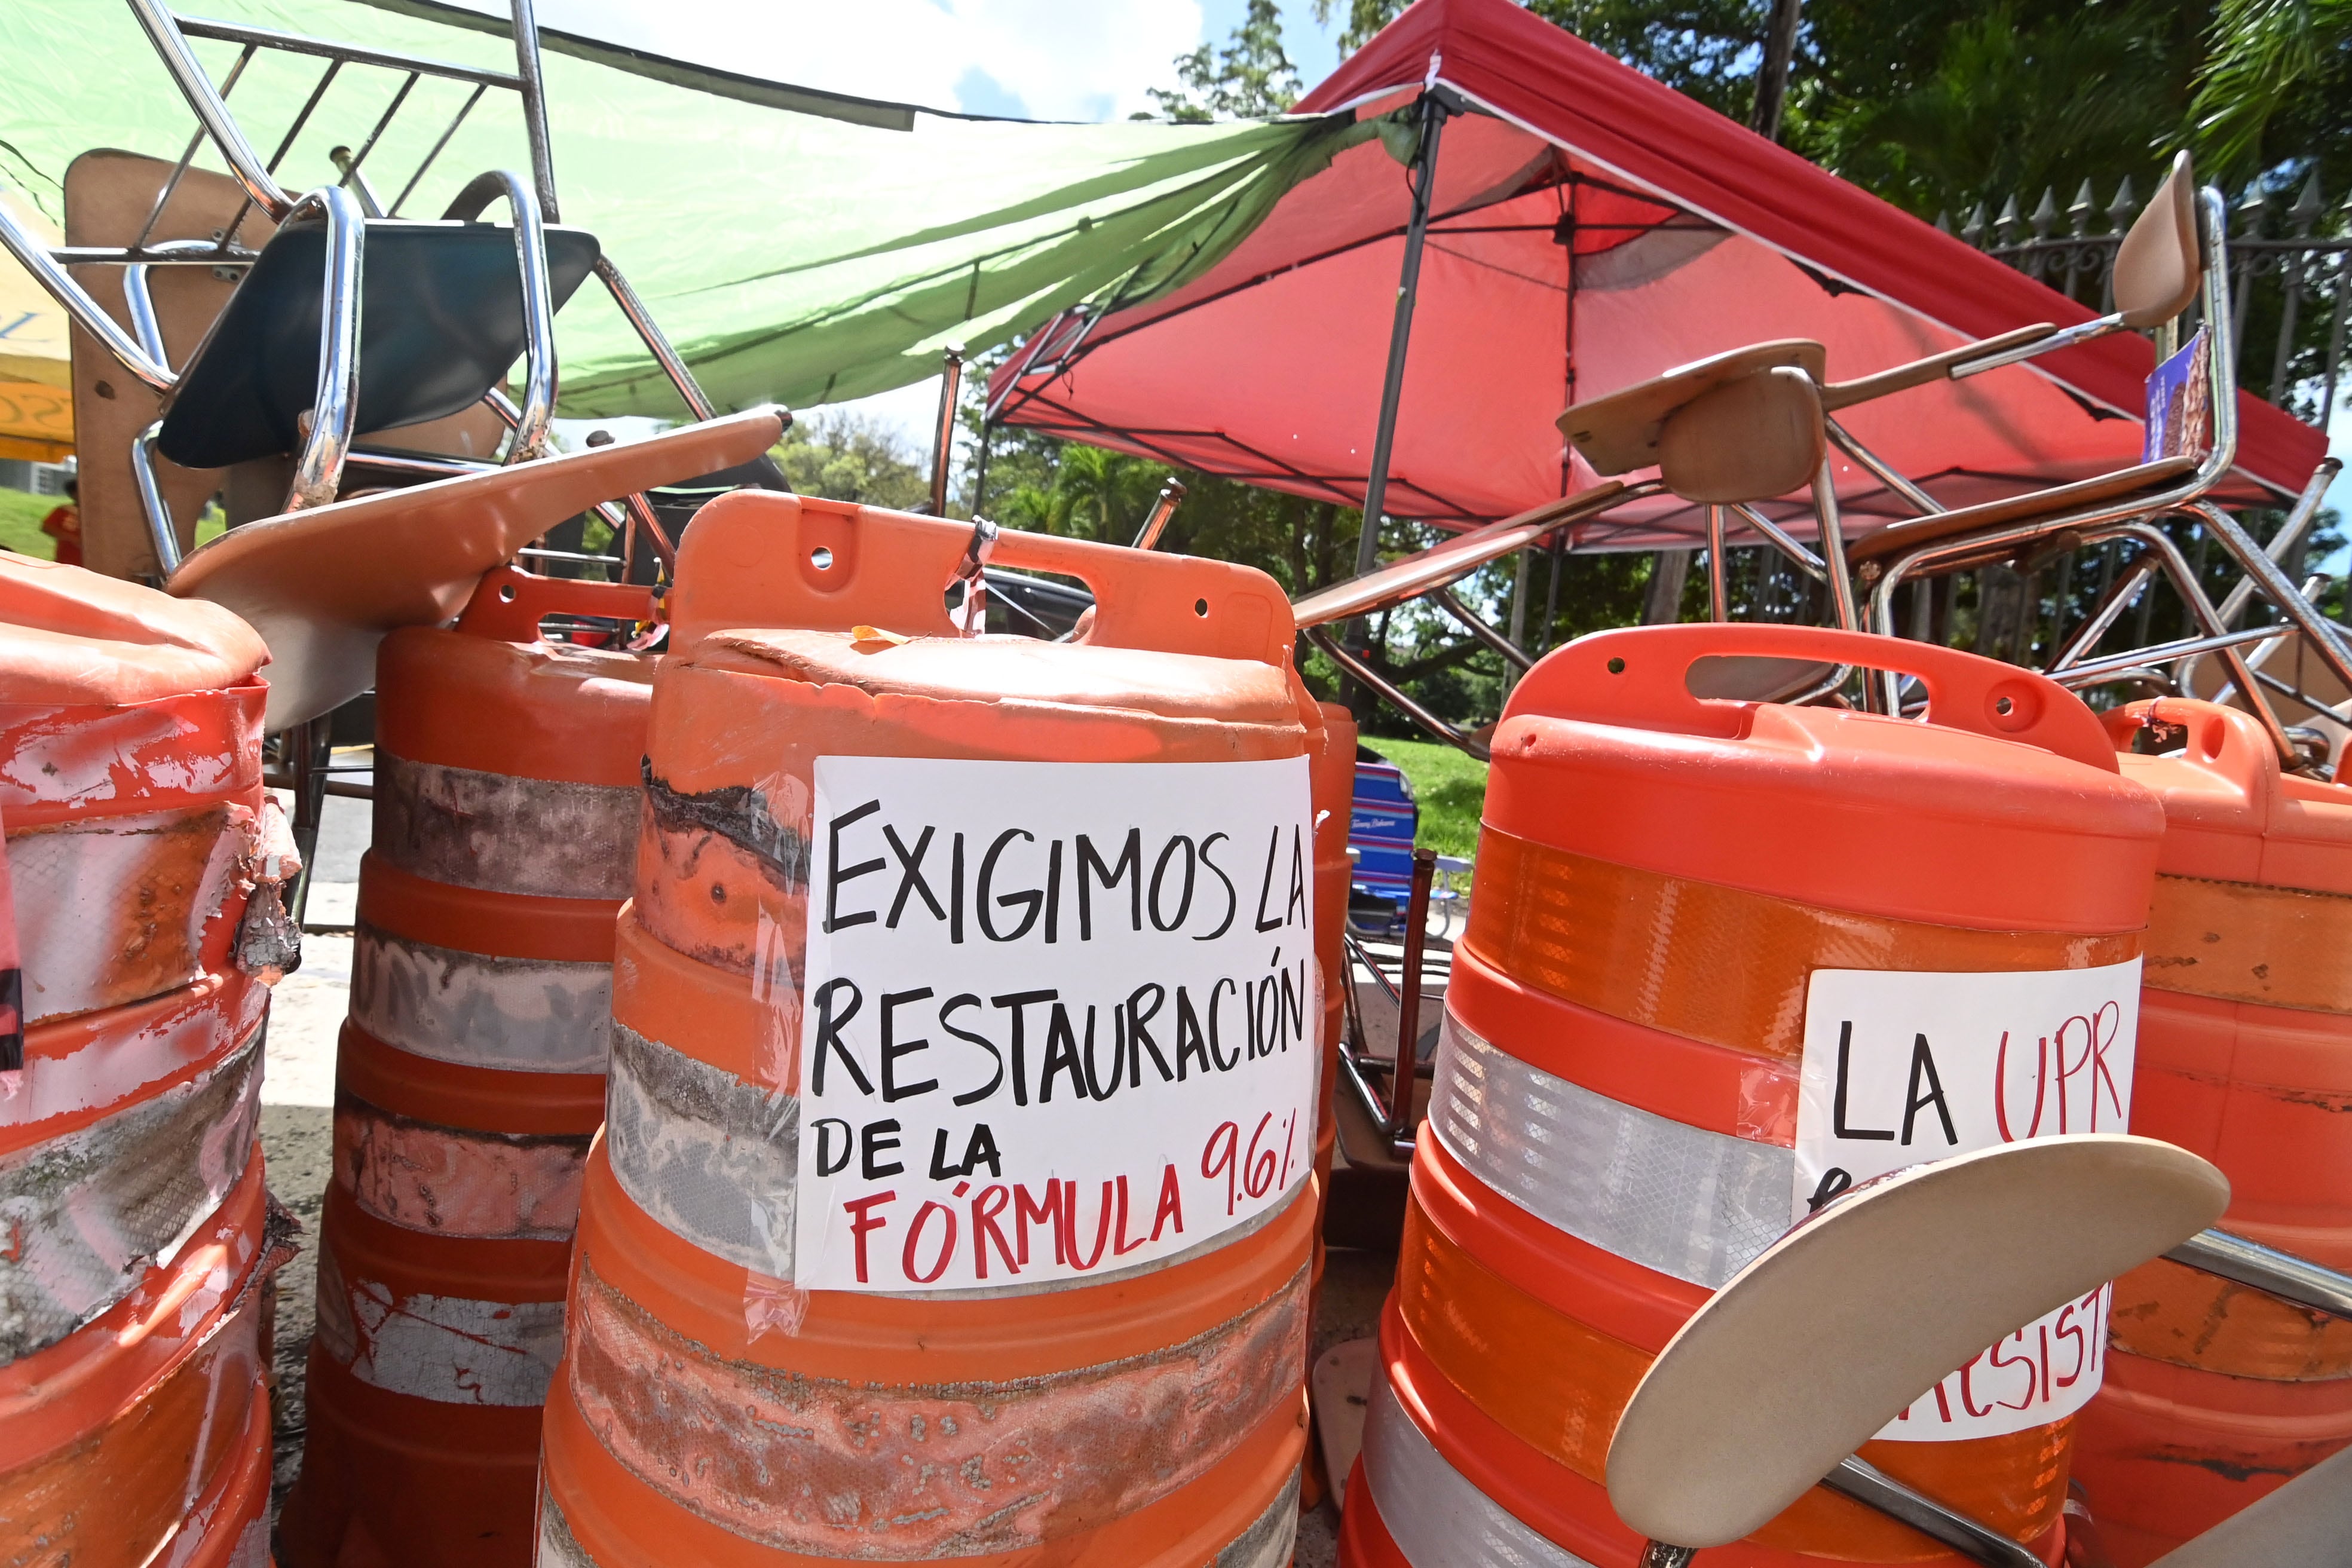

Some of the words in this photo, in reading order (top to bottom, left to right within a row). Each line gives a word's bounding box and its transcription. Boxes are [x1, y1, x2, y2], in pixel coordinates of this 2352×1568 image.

[822, 799, 1236, 944] EXIGIMOS
[1255, 823, 1306, 933] LA
[811, 946, 1305, 1107] RESTAURACIÓN
[1833, 1021, 1958, 1146] LA
[1995, 1000, 2122, 1143] UPR
[810, 1118, 905, 1181] DE
[929, 1123, 1002, 1181] LA
[843, 1163, 1184, 1284] FÓRMULA
[1201, 1107, 1296, 1216] 9.6%
